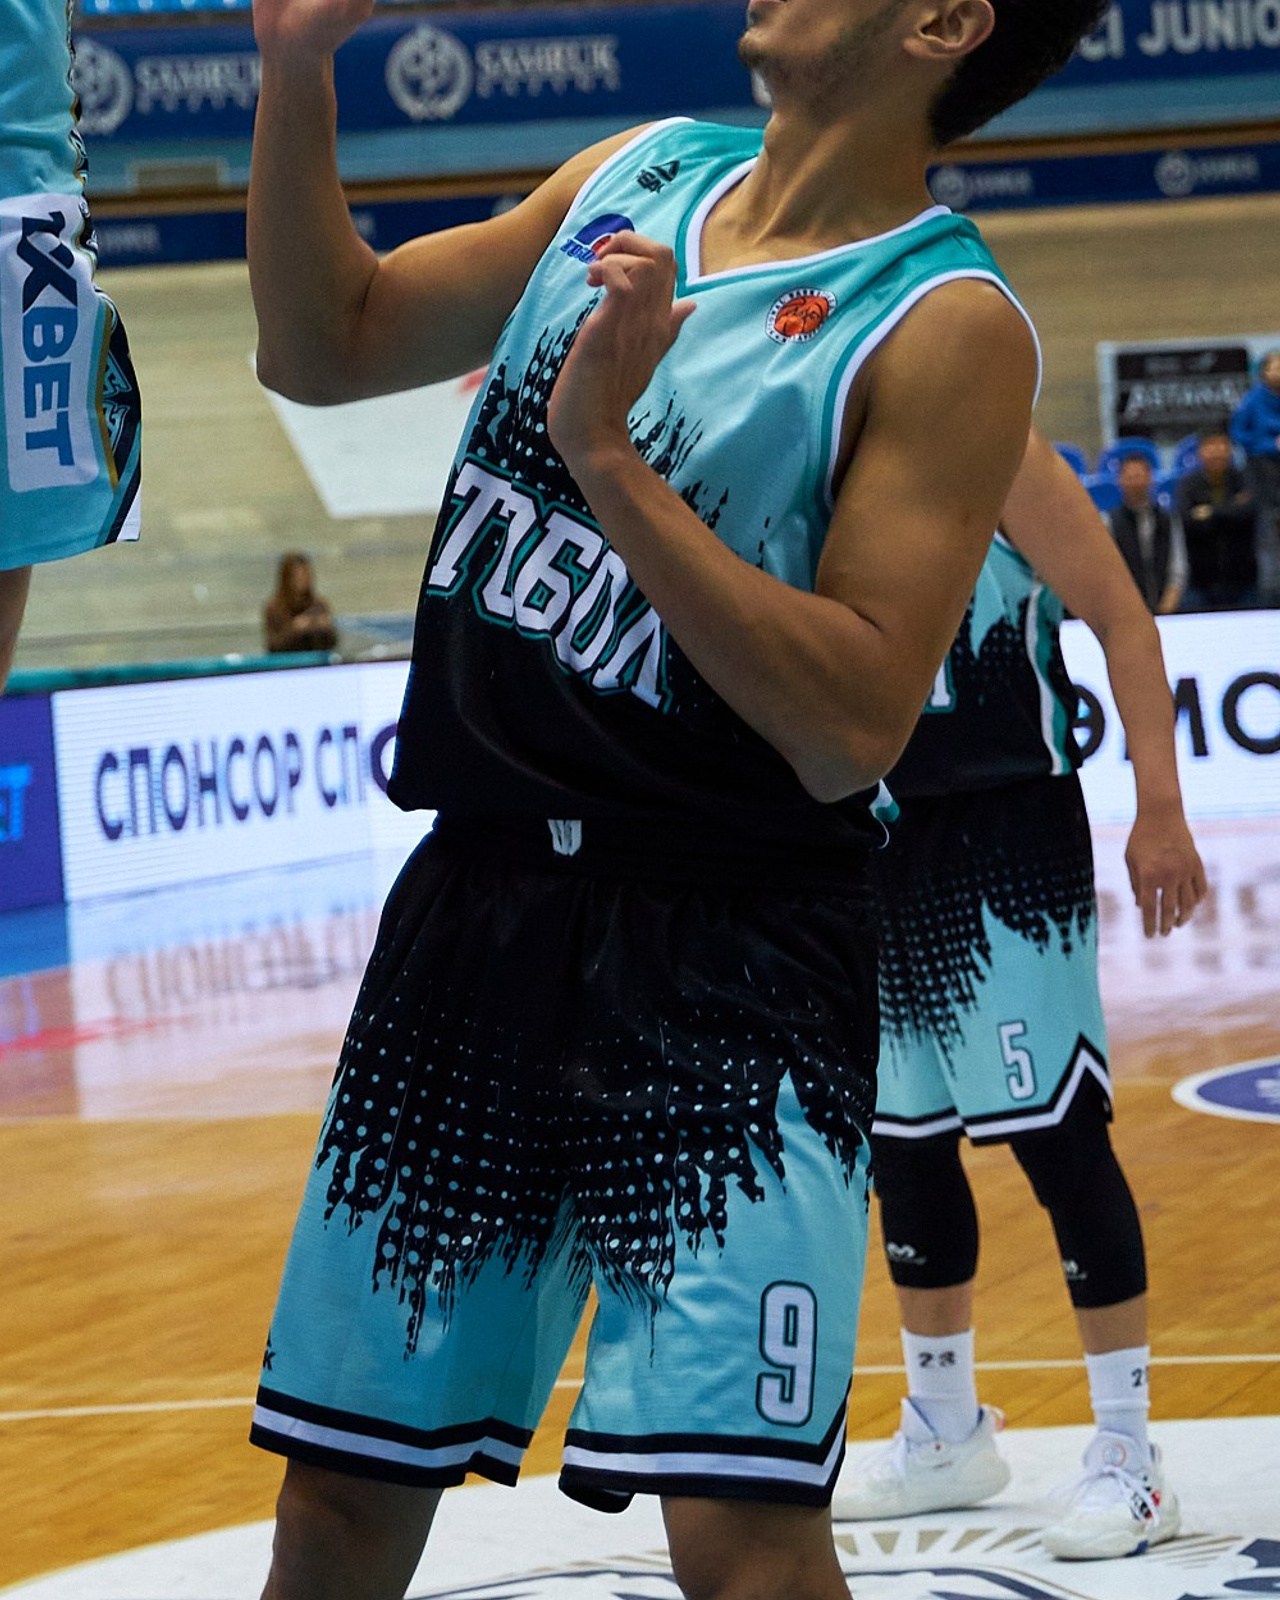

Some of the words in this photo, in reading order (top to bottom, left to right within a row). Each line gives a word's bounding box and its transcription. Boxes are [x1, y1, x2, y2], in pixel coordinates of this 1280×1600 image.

[17, 211, 78, 466] 1XBET
[96, 732, 302, 841] СПОНСОР
[997, 1020, 1036, 1100] 5
[756, 1280, 818, 1427] 9
